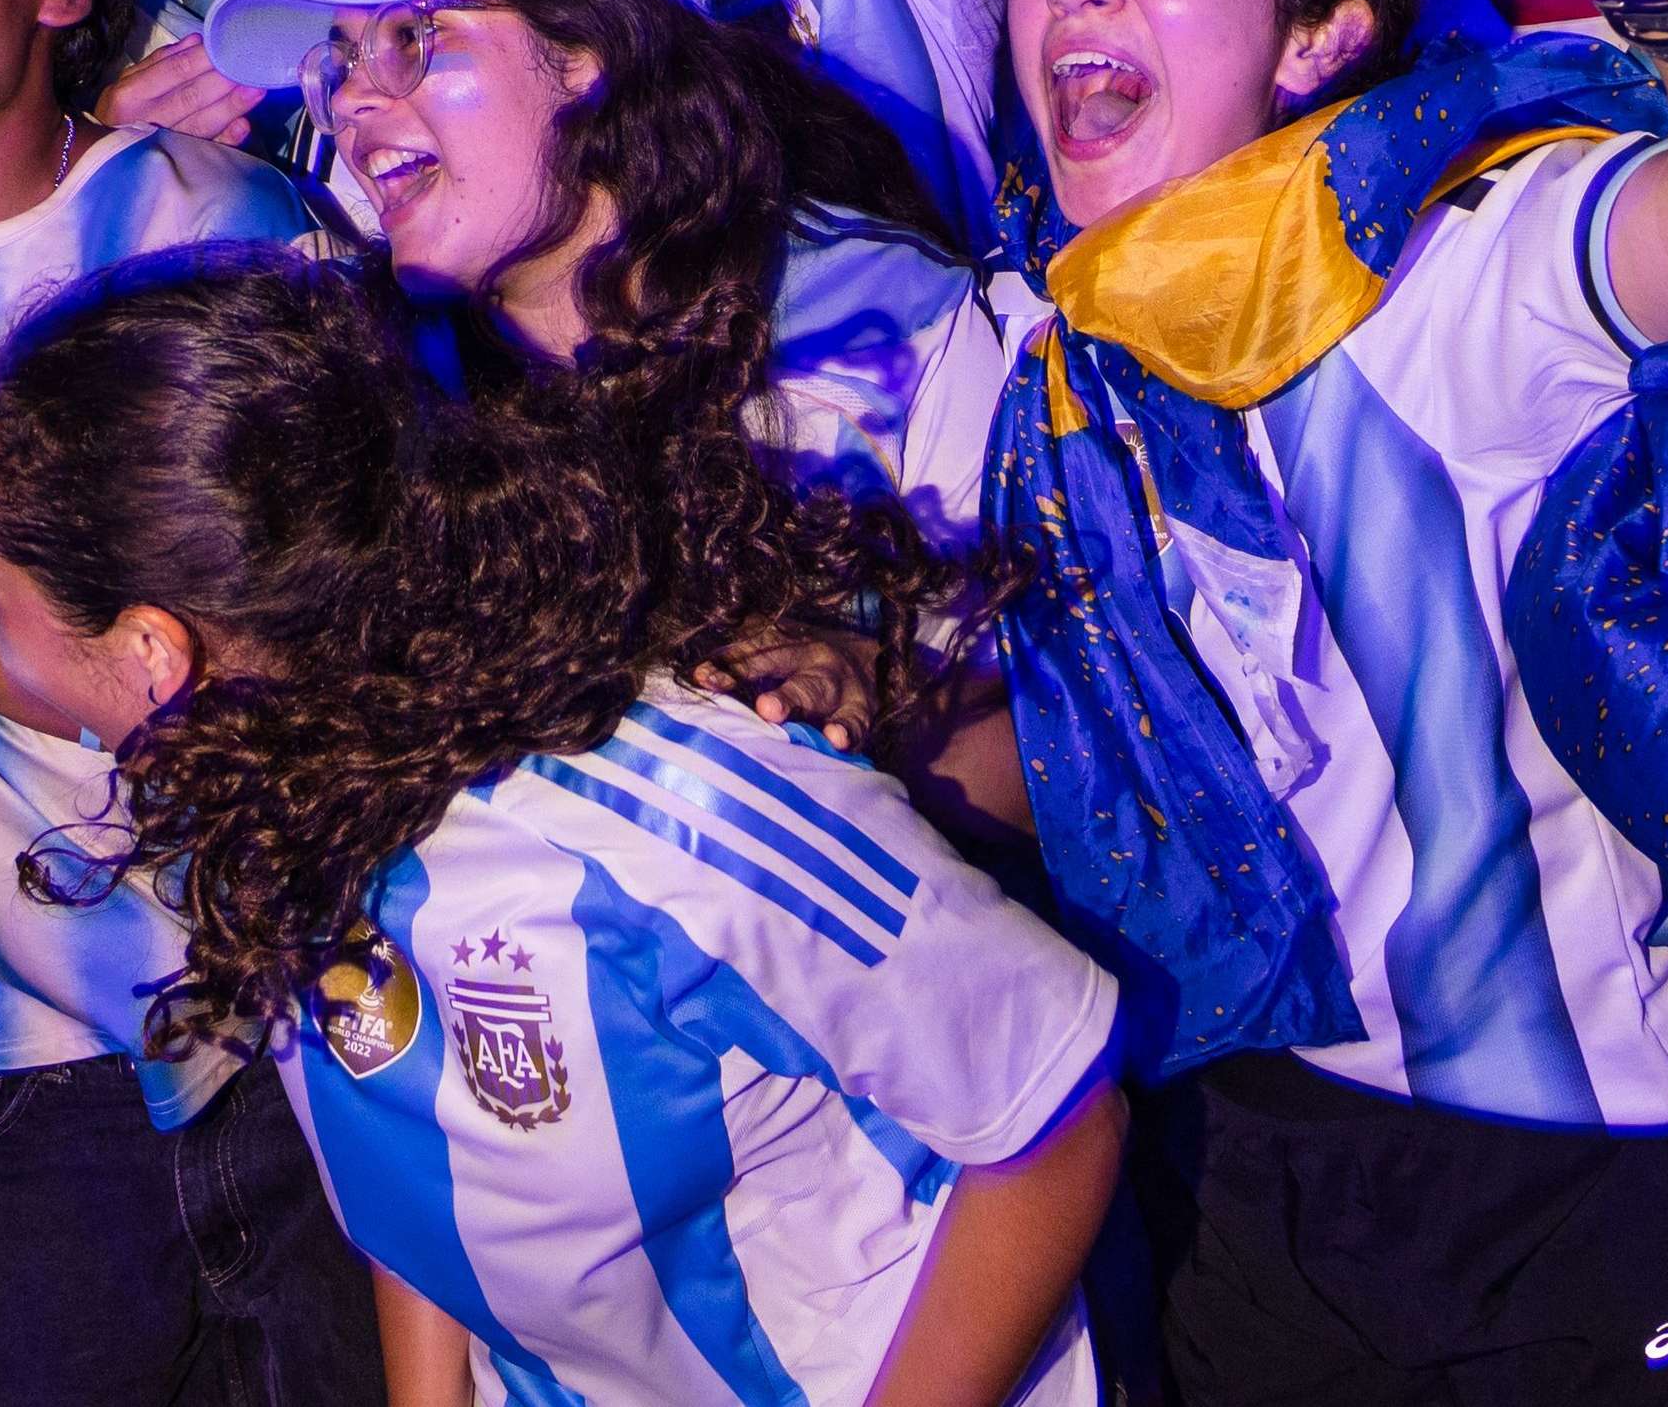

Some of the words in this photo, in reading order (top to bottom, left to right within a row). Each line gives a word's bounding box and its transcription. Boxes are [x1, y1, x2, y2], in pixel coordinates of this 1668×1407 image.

[338, 1010, 387, 1041] FIFA
[343, 1039, 372, 1058] 2022
[475, 1016, 542, 1090] AFA
